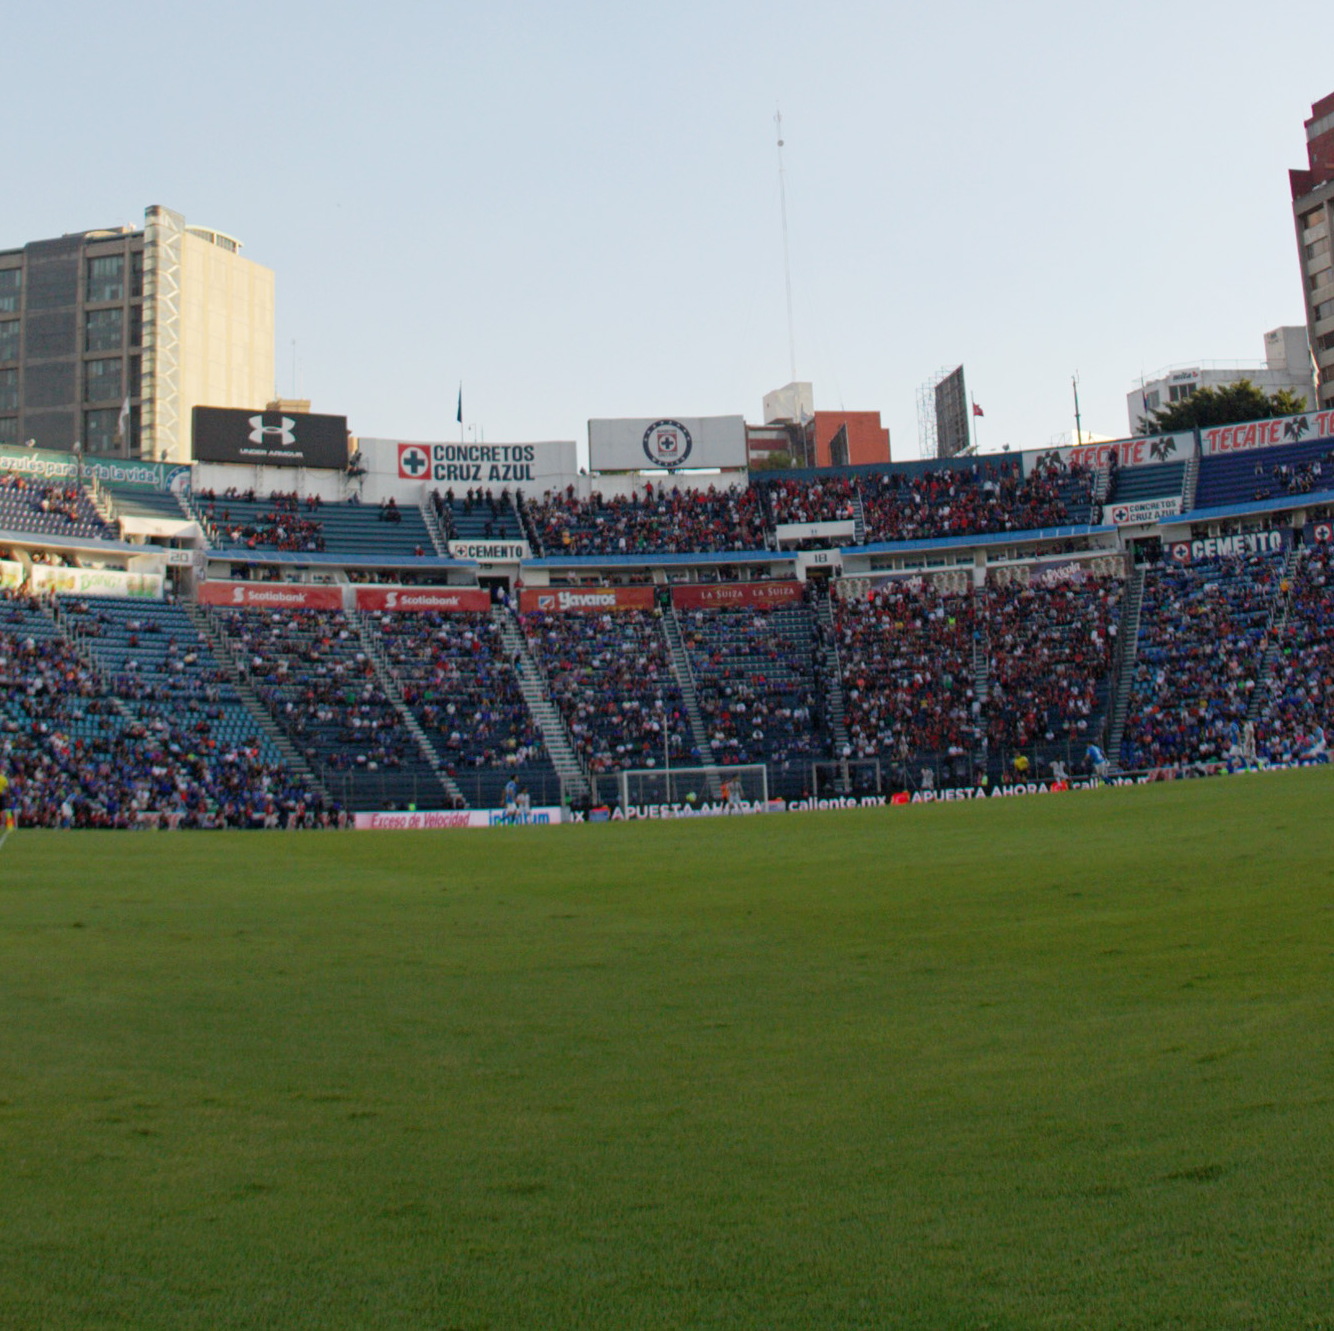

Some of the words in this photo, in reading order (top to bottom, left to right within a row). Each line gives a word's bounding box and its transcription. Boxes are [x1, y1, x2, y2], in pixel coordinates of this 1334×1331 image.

[1205, 419, 1284, 453] TECATE
[239, 448, 267, 457] UNDER
[268, 450, 304, 458] ARMOUR
[433, 445, 535, 462] CONCRETOS
[46, 461, 79, 479] para
[110, 464, 125, 480] la
[433, 464, 481, 481] CRUZ
[488, 464, 536, 481] AZUL
[1130, 499, 1177, 513] CONCRETOS
[1130, 512, 1153, 522] CRUZ
[467, 544, 524, 559] CEMENTO
[1191, 530, 1283, 560] CEMENTO
[170, 552, 190, 564] 20
[814, 553, 828, 564] 18
[247, 588, 305, 604] Scotiabank
[401, 593, 460, 606] Scotiabank
[557, 590, 616, 610] Yavaros
[701, 591, 714, 599] LA
[753, 588, 765, 597] LA
[612, 802, 693, 821] APUESTA
[787, 794, 887, 813] caliente.mx
[911, 786, 987, 804] APUESTA
[990, 782, 1050, 798] AHORA
[370, 813, 407, 828] Exceso
[408, 813, 421, 828] de
[423, 811, 471, 827] Velocidad
